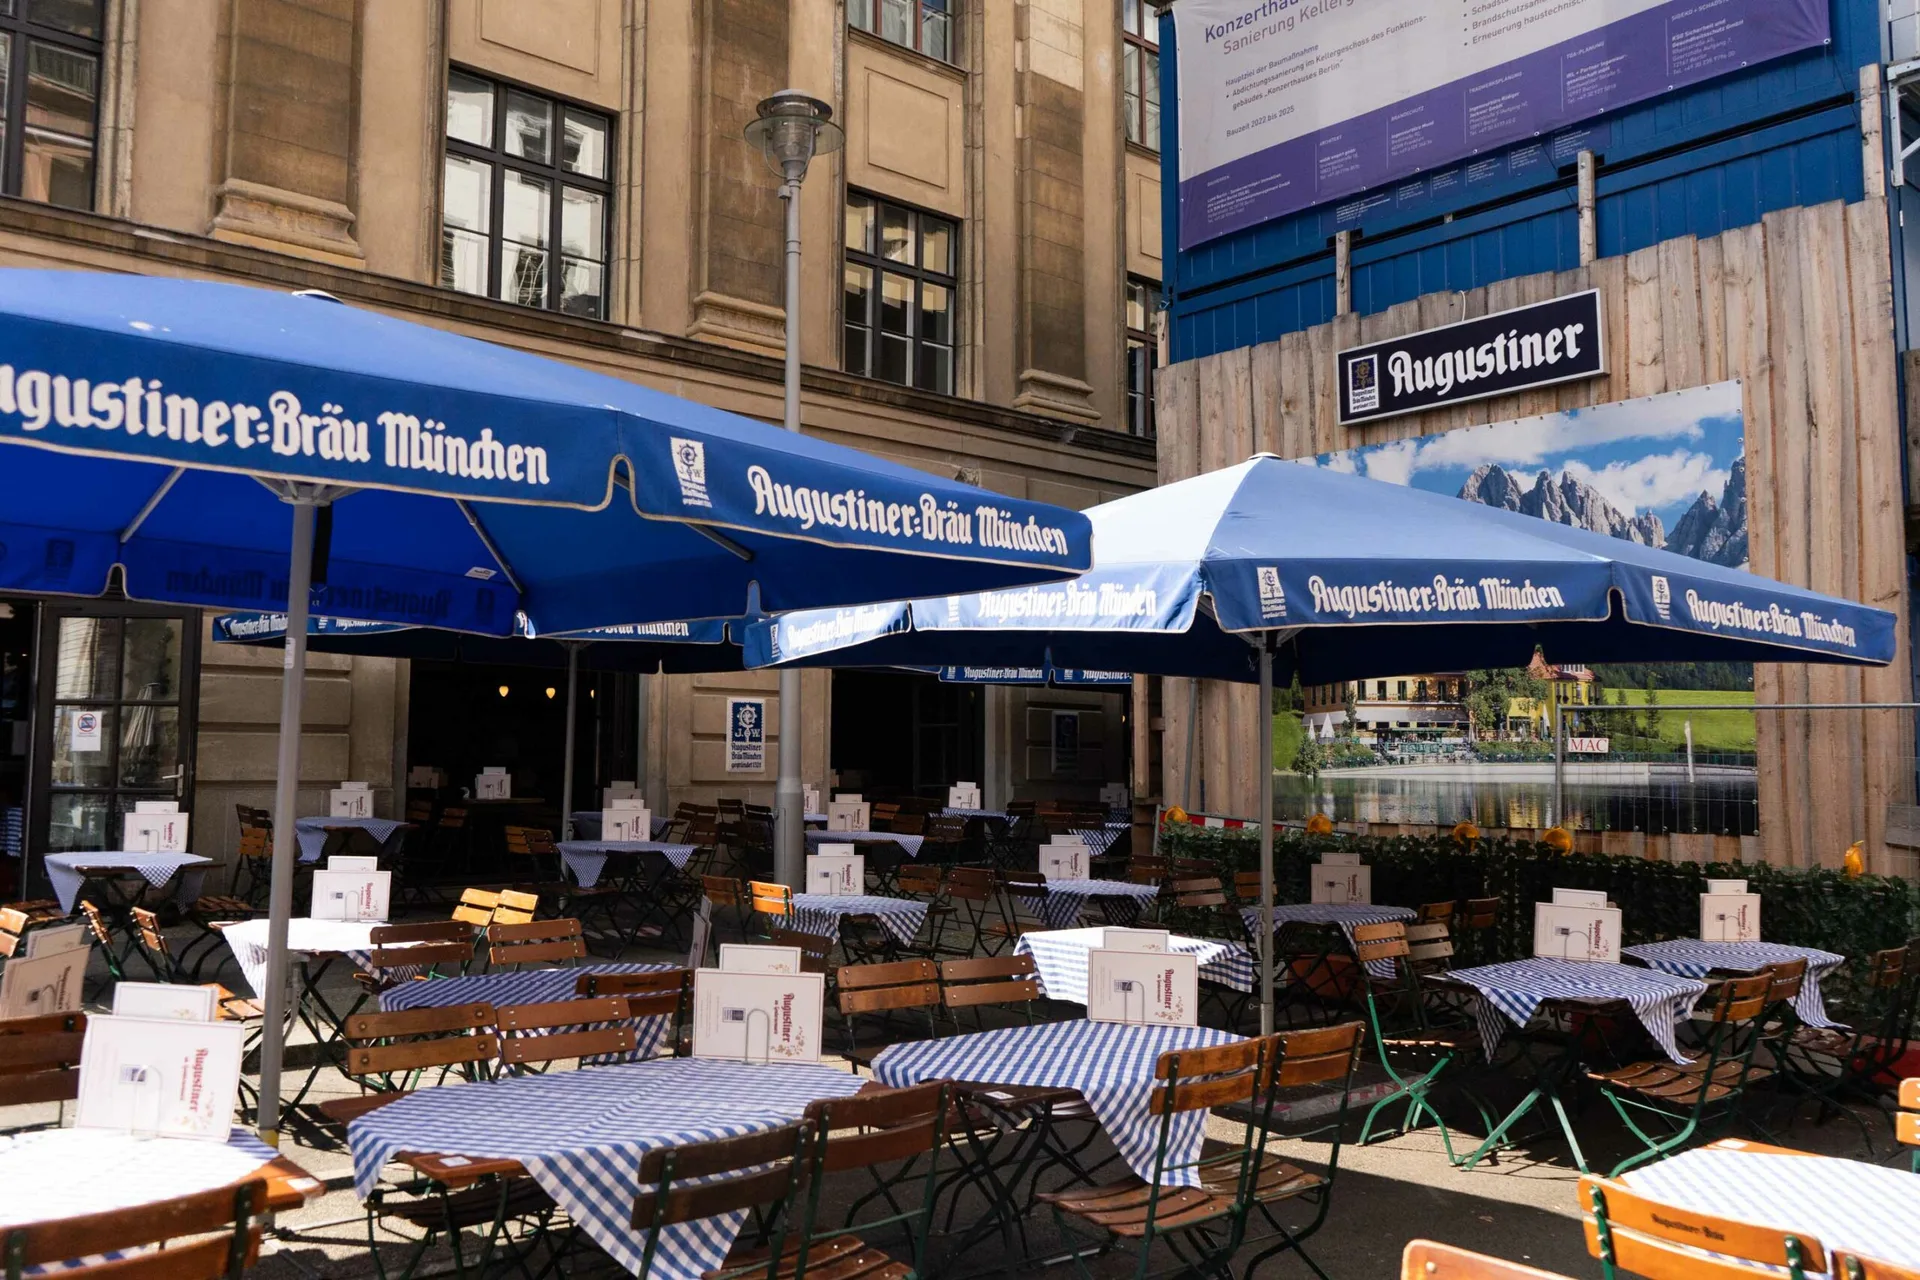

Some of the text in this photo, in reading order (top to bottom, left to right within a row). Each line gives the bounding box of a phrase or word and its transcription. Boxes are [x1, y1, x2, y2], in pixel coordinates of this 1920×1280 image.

[1205, 0, 1302, 43] Konzerthau
[1223, 15, 1295, 54] Sanierung
[1472, 20, 1522, 45] Erneuerung
[1225, 44, 1319, 86] Hauptziel der Baumaßnahme
[1232, 16, 1427, 97] Abdichtungssanierung im Kellergeschoss des Funktions-
[1226, 105, 1295, 137] Bauzeit 2022 bis 2025
[1232, 91, 1263, 111] gebäudes
[1388, 322, 1584, 396] Augustiner
[376, 411, 550, 484] München
[975, 505, 1068, 556] München
[1098, 582, 1157, 617] München
[1480, 577, 1565, 610] München
[1801, 611, 1857, 647] München
[1571, 738, 1607, 751] MAC
[1163, 968, 1174, 1010] Augustiner
[781, 992, 795, 1043] Augustiner
[189, 1047, 209, 1112] Augustiner
